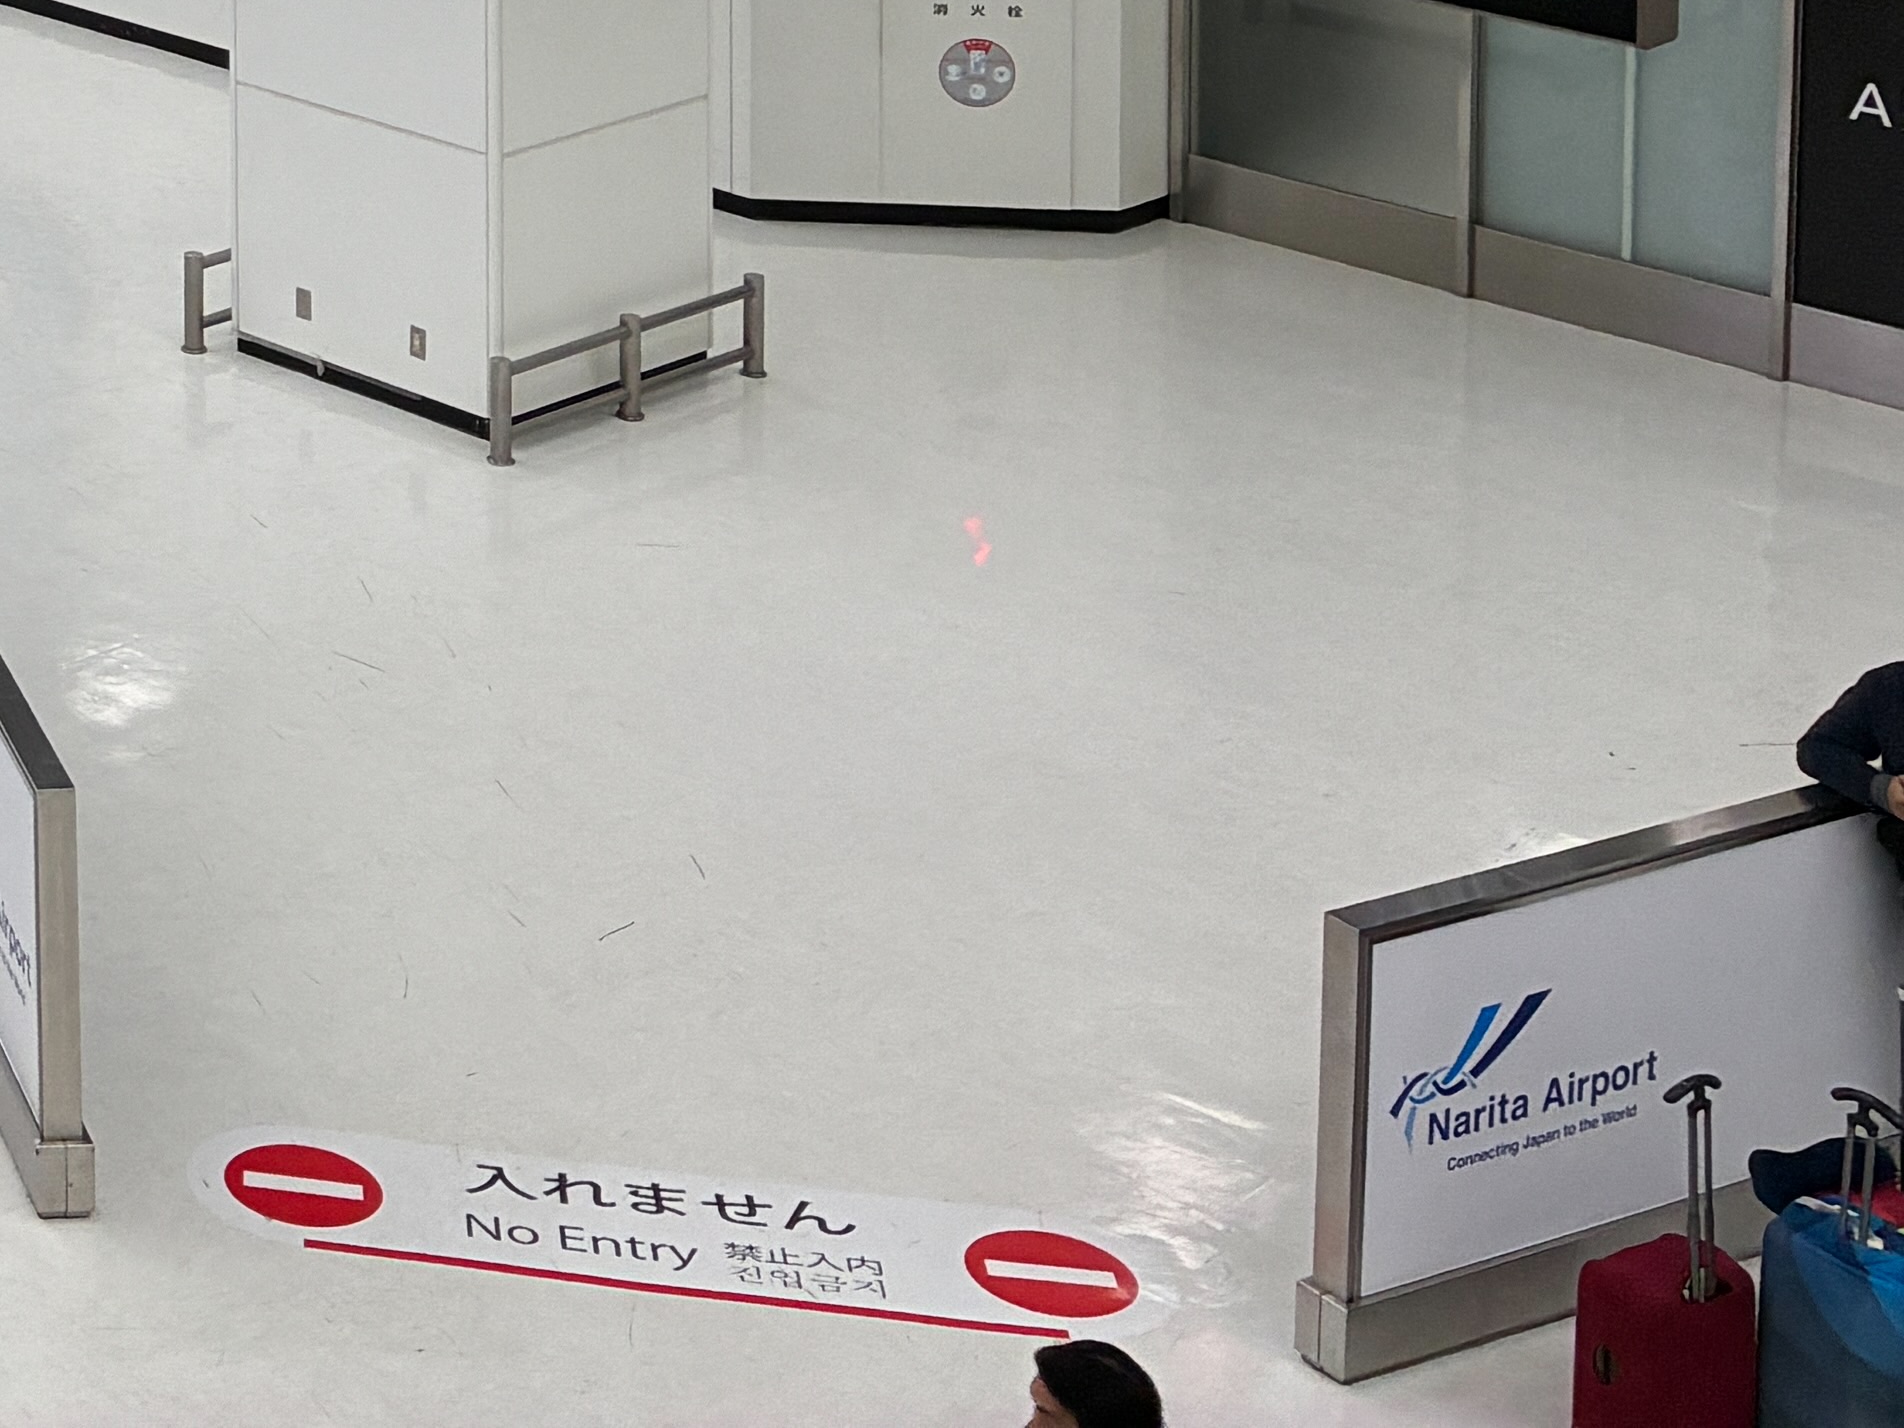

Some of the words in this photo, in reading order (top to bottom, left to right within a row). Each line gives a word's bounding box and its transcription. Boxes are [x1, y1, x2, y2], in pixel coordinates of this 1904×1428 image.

[1849, 82, 1892, 128] A
[1428, 1093, 1528, 1145] Narita
[1543, 1051, 1658, 1112] Airport
[1447, 1138, 1519, 1171] Connecting
[1522, 1128, 1561, 1151] Japan
[1563, 1122, 1576, 1138] to
[1579, 1115, 1599, 1133] the
[1601, 1104, 1638, 1125] World
[466, 1164, 856, 1236] 入れません
[466, 1213, 540, 1246] No
[559, 1225, 697, 1271] Entry
[724, 1242, 884, 1277] 禁止入内
